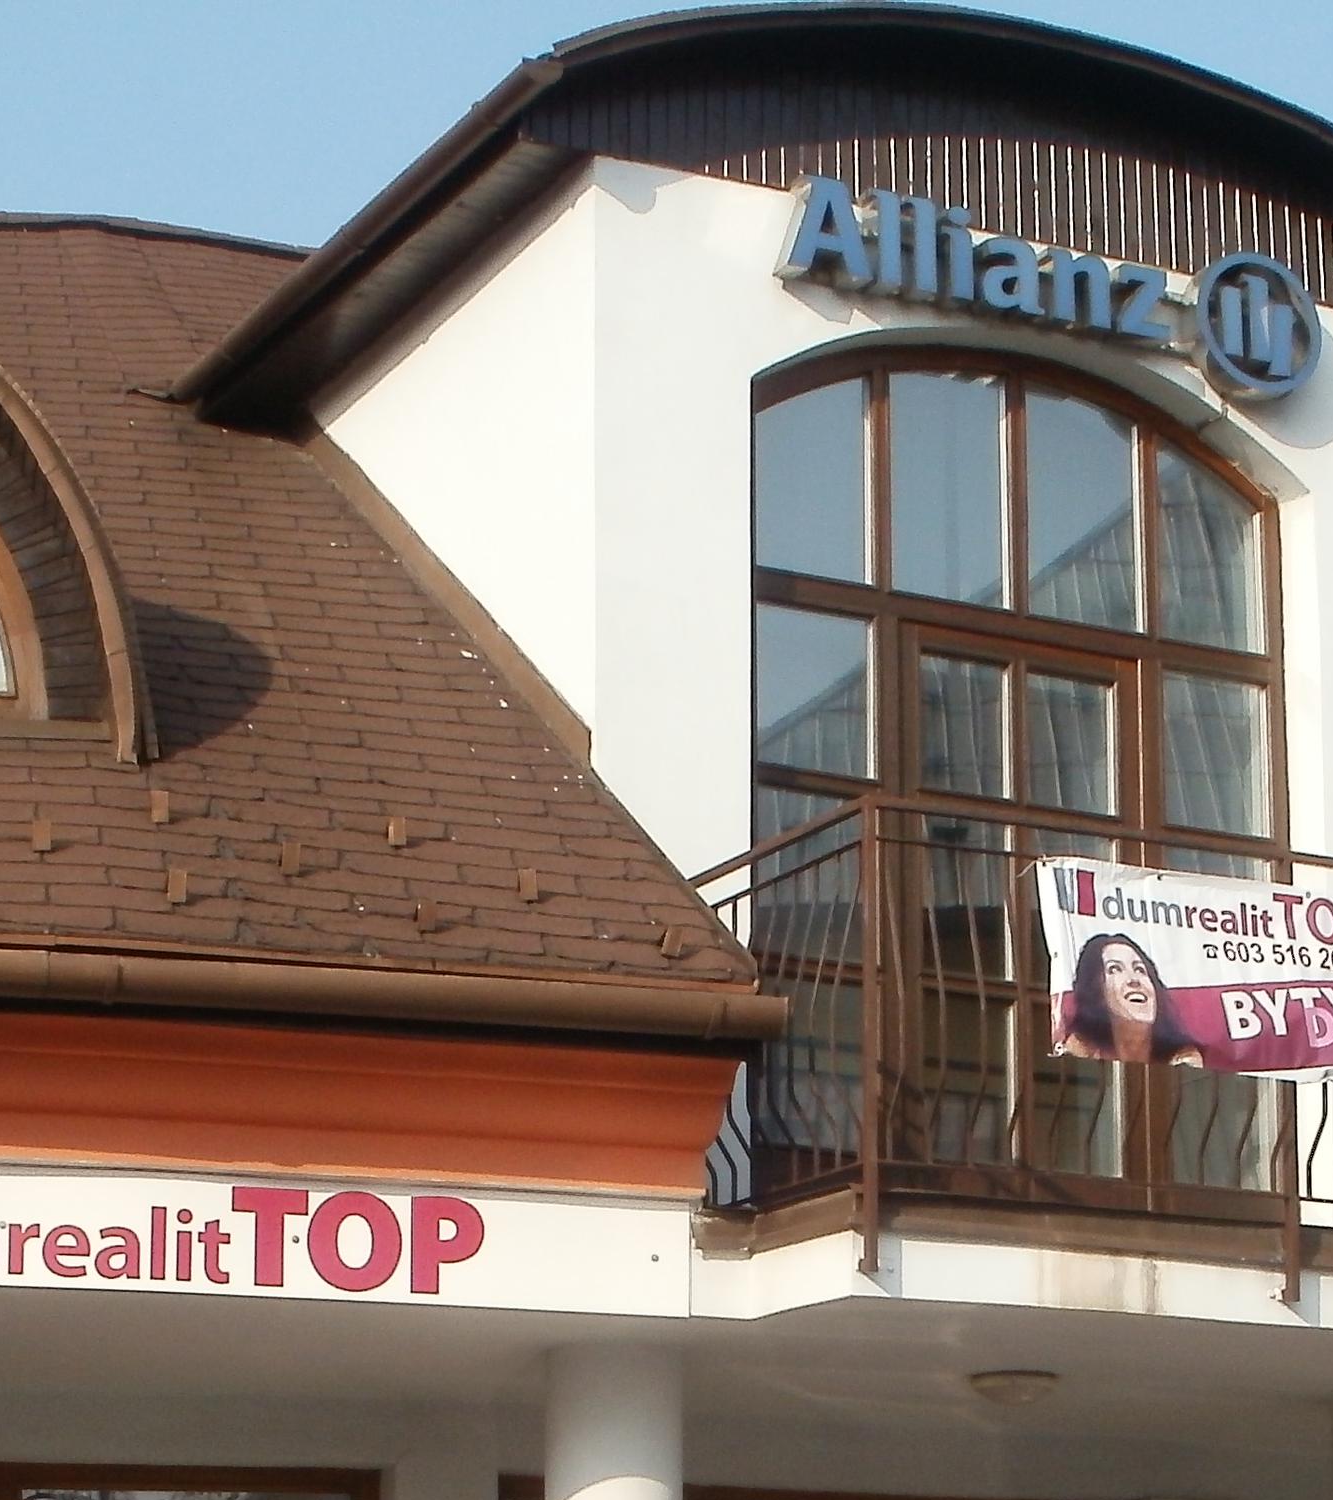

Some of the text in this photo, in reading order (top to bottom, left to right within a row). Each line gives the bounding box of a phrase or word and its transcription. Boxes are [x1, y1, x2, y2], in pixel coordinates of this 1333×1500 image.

[772, 174, 1170, 340] Allianz
[1223, 943, 1265, 965] 603
[1272, 945, 1312, 968] 516
